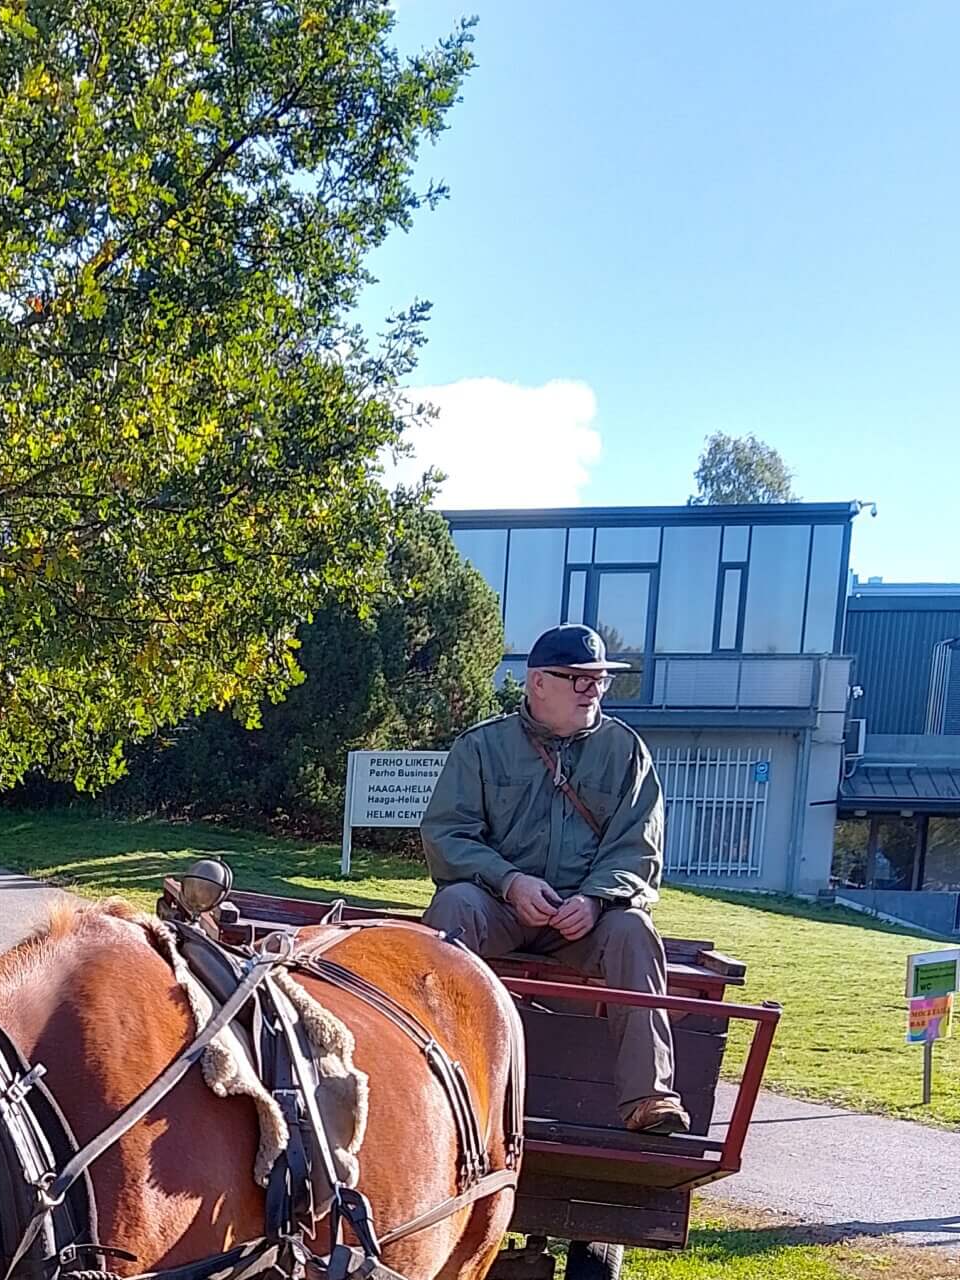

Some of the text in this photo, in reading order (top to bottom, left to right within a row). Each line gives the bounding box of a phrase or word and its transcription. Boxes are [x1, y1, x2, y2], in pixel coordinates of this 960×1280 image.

[370, 759, 403, 767] PERHO
[369, 769, 439, 777] Perho Business
[368, 785, 432, 793] HAAGA-HELIA
[367, 795, 420, 805] Haaga-Helia
[366, 811, 395, 819] HELMI
